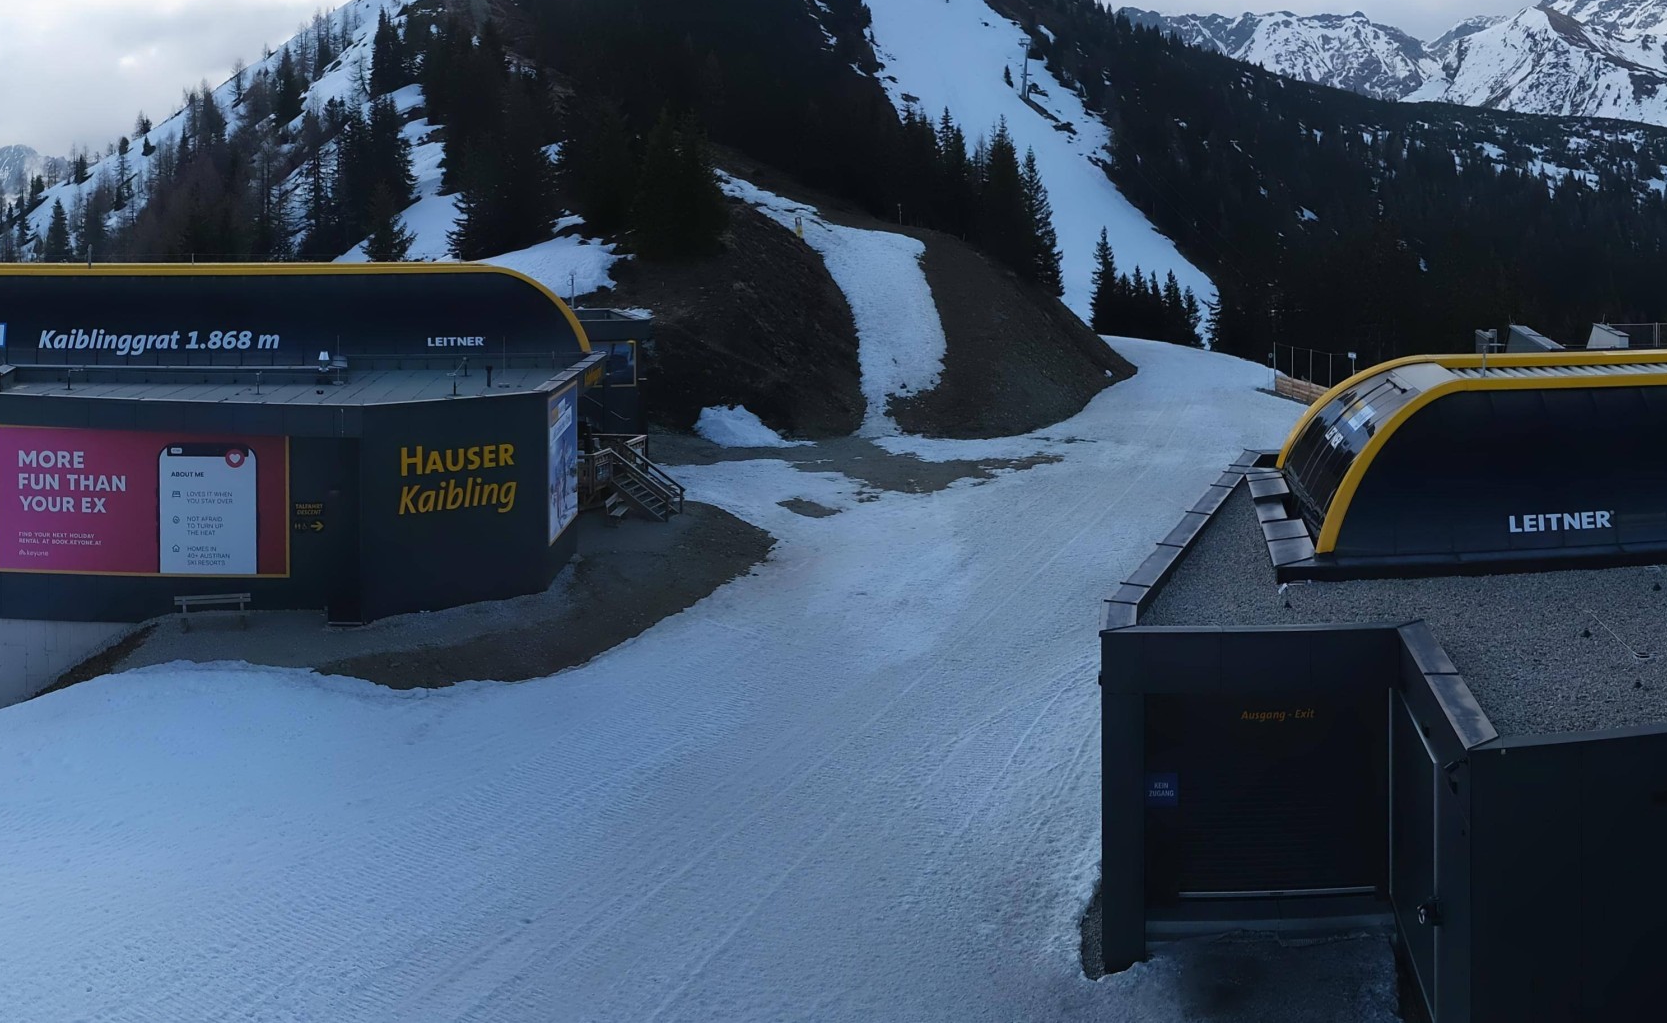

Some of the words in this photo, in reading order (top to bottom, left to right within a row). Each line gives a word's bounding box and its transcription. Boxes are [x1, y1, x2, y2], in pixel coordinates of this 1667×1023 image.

[38, 329, 180, 356] Kaiblinggrat
[185, 330, 252, 350] 1.868
[257, 335, 280, 349] m
[18, 450, 85, 469] MORE
[400, 443, 515, 477] HAUSER
[18, 473, 60, 490] FUN
[66, 474, 127, 492] THAN
[19, 495, 75, 513] YOUR
[81, 497, 107, 514] EX
[398, 477, 517, 515] Kaibling
[1241, 710, 1285, 722] Ausgang
[1295, 708, 1315, 719] Exit
[1149, 789, 1174, 797] ZUGANG
